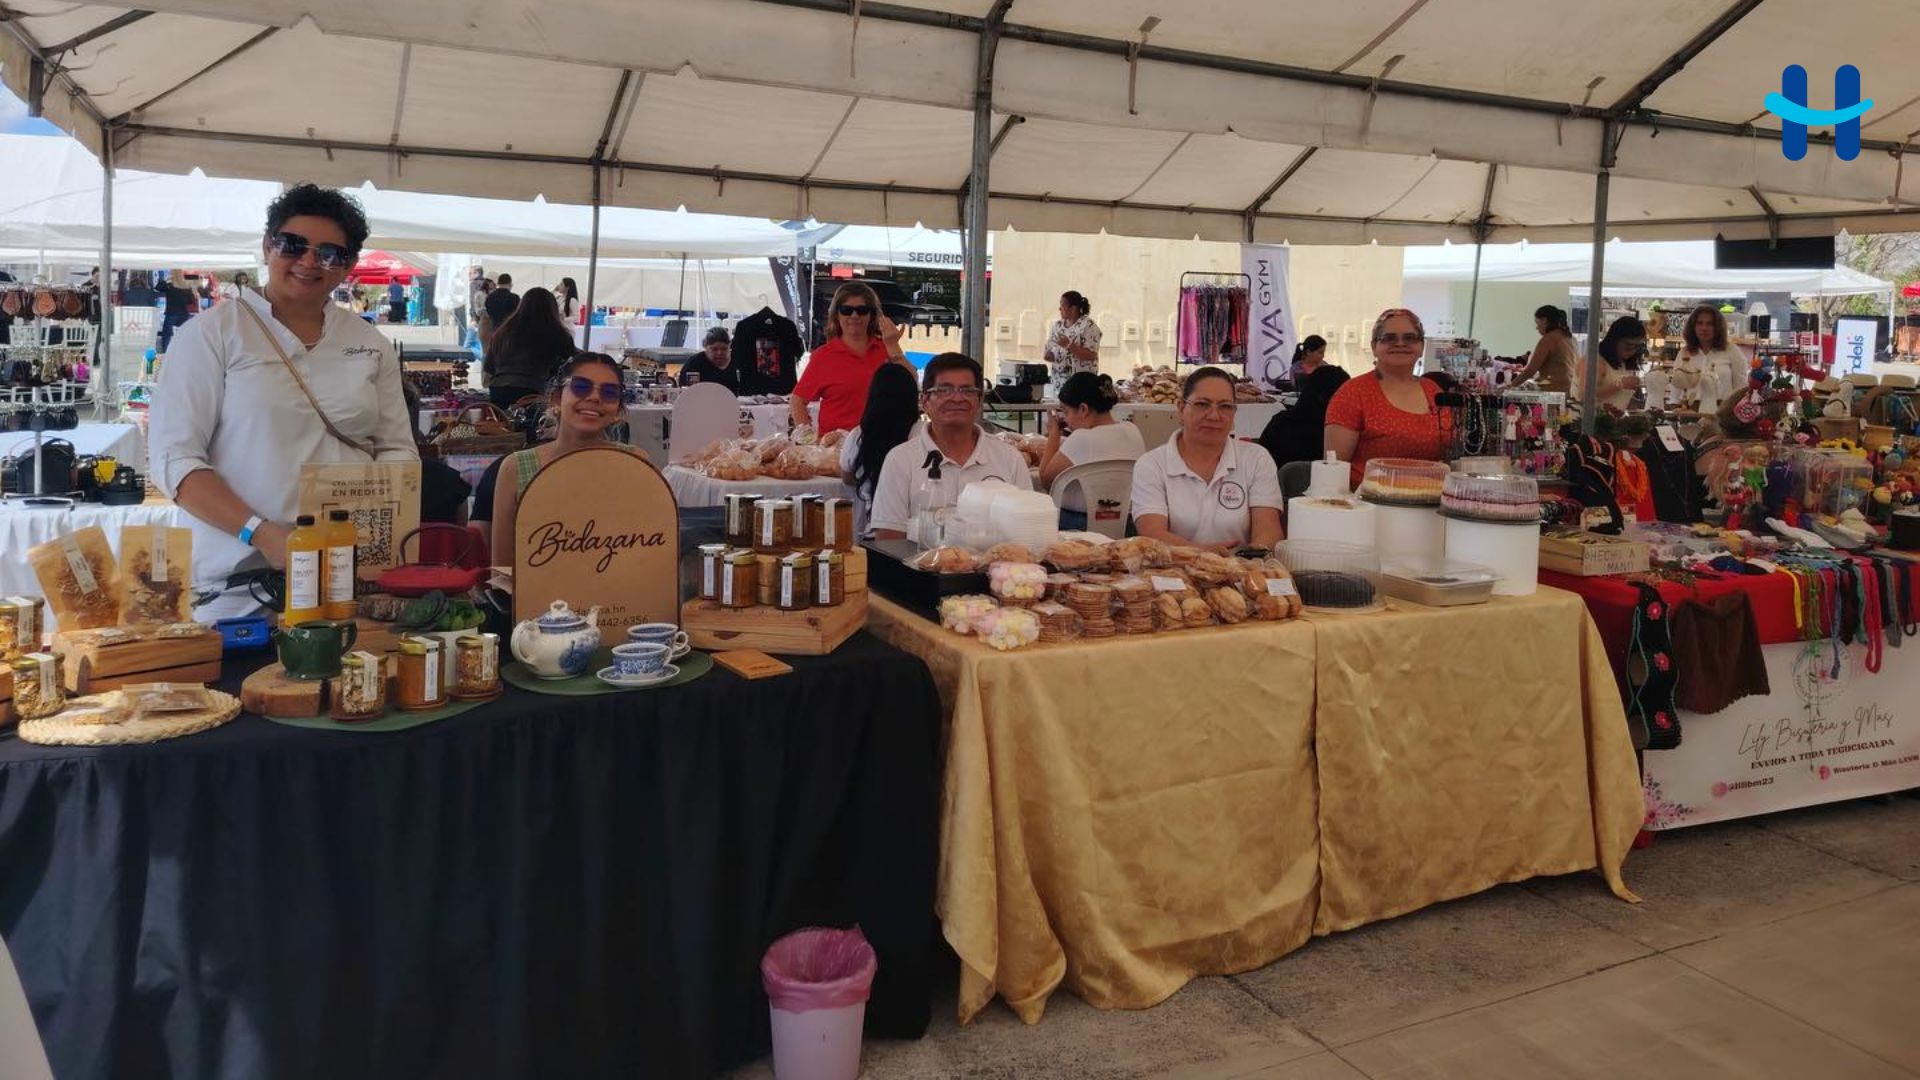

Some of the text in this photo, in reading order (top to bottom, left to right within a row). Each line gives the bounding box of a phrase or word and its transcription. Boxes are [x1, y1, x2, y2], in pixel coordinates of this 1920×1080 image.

[1257, 259, 1271, 305] GYM
[1751, 738, 1896, 770] ENVIOS A TODA TEGUCIGALPA
